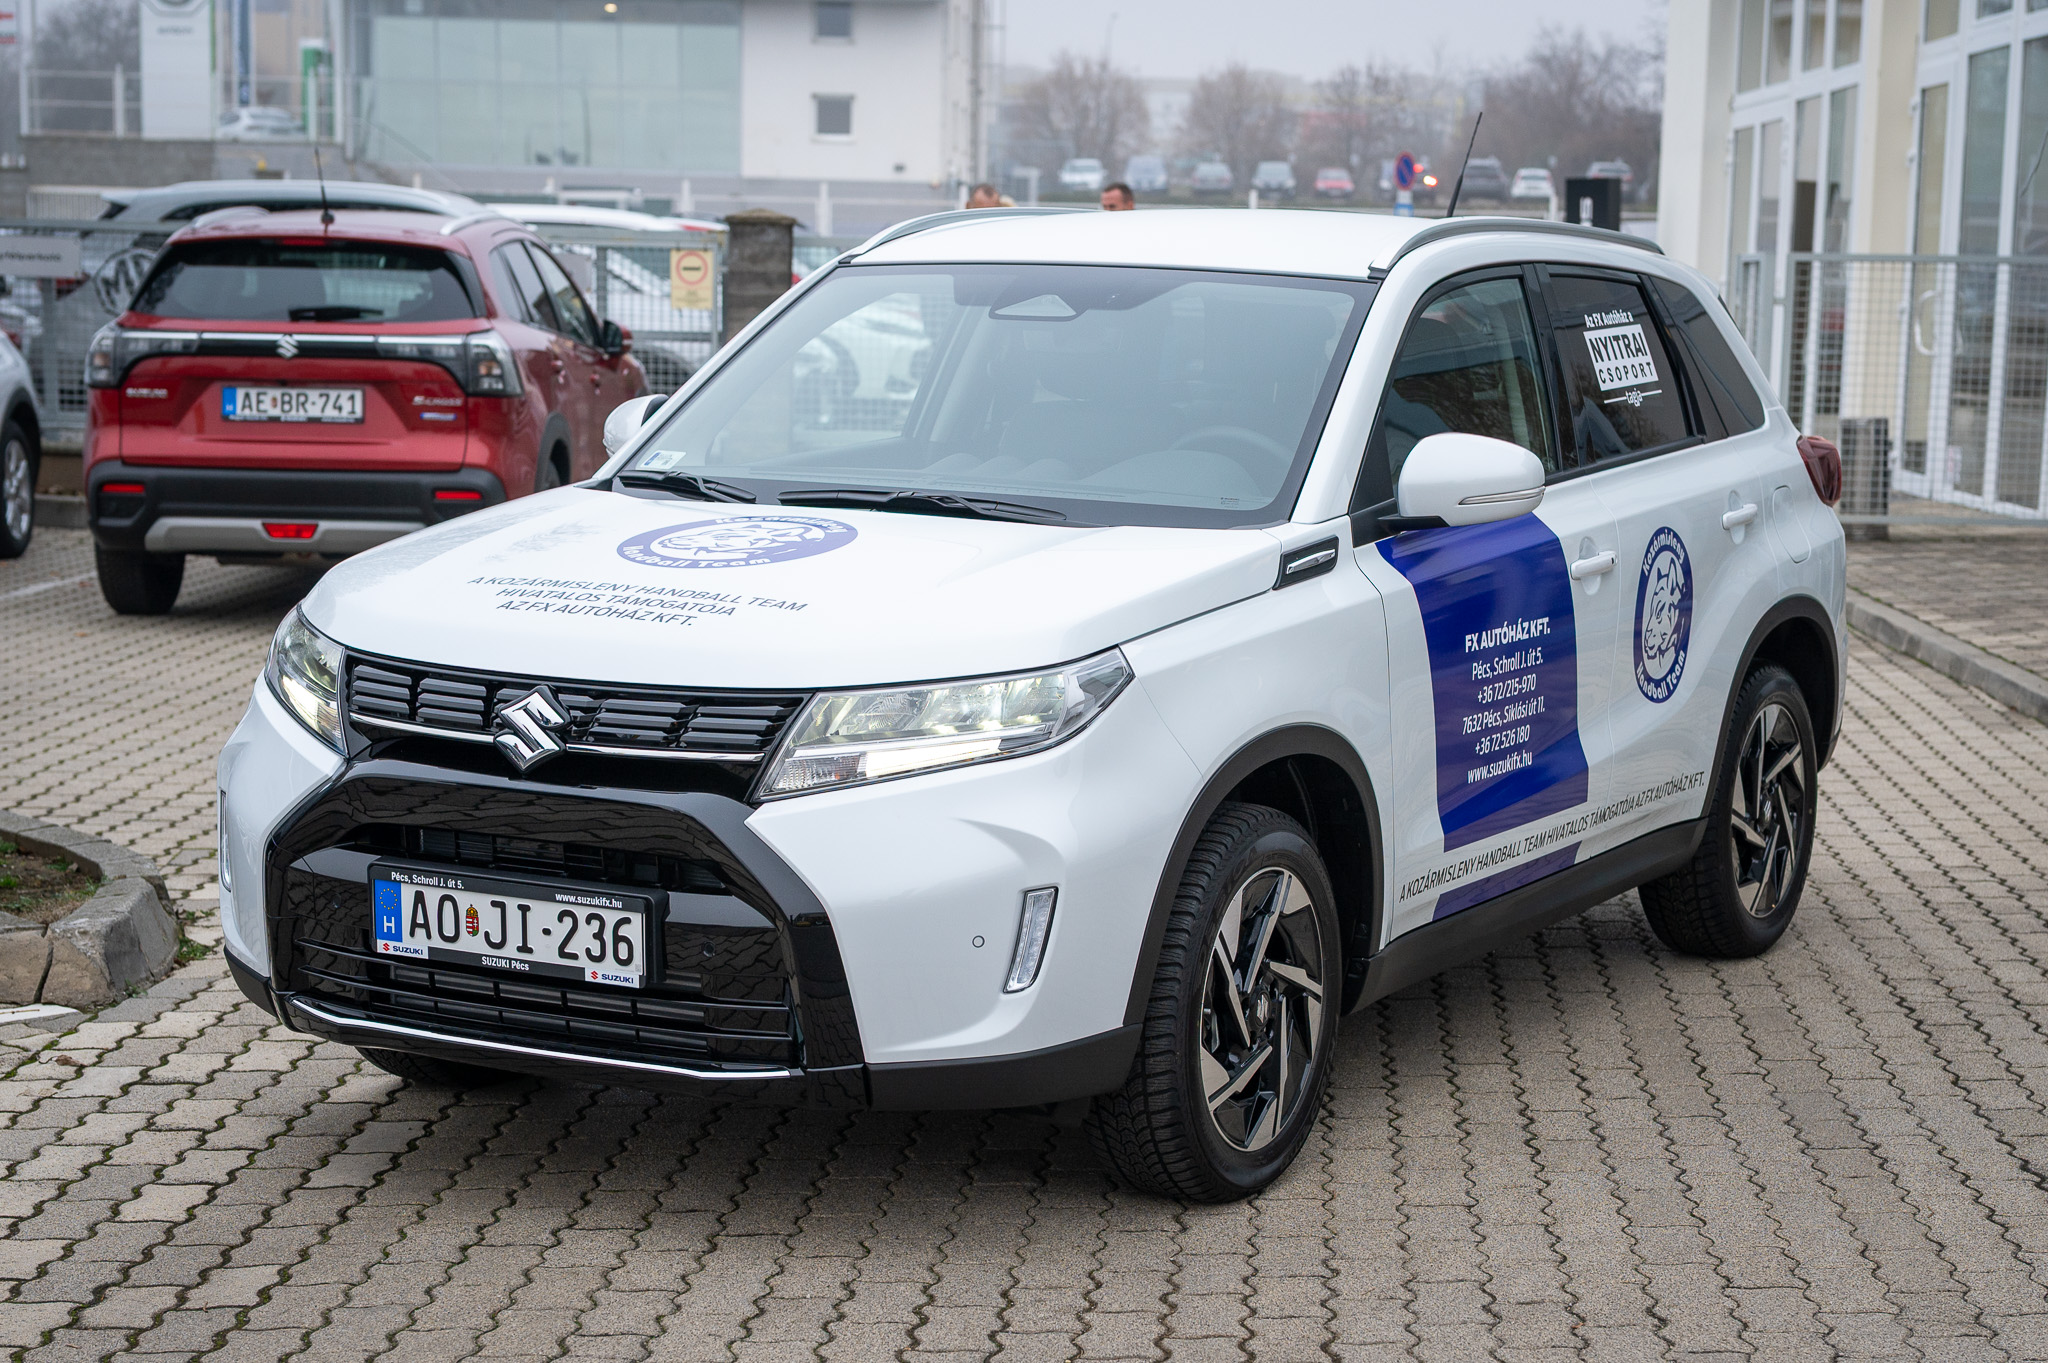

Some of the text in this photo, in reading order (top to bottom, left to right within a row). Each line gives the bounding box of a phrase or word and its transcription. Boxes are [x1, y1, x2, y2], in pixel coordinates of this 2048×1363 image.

[1584, 313, 1595, 328] Az
[1592, 312, 1604, 326] FX
[1627, 311, 1634, 322] a
[1588, 332, 1648, 363] NYITRAI
[1598, 361, 1653, 384] CSOPORT
[241, 391, 268, 413] AE
[1625, 387, 1643, 407] tagja
[697, 558, 771, 568] Team
[484, 577, 639, 592] KOZÁRMISLENY
[635, 586, 742, 604] HANDBALL
[748, 597, 809, 611] TEAM
[496, 588, 736, 616] HIVATALOS TÁMOGATÓJA
[496, 601, 698, 626] AZ FX AUTÓHÁZ KFT.
[1465, 616, 1551, 653] FX AUTÓHÁZ KFT.
[1472, 647, 1543, 681] Pécs, Schroll J. út 5.
[1636, 650, 1685, 699] Handball Team
[1477, 673, 1537, 704] +36 72/215-970
[1462, 696, 1545, 735] 7632 Pécs, Siklósi út 11.
[1475, 724, 1530, 755] +36 72 526 180
[1467, 749, 1533, 784] www.suzukifx.hu
[1399, 771, 1705, 903] A KOZÁRMISLENY HANDBALL TEAM HIVATALOS TÁMOGATÓJA AZ FX AUTÓHÁZ KFT.
[391, 872, 464, 889] Pécs, Schroll J. út 5.
[555, 893, 622, 908] www.suzukifx.hu
[383, 915, 395, 934] H
[409, 890, 634, 967] AO JI-236
[392, 945, 423, 956] SUZUKI
[482, 956, 529, 971] SUZUKI Pécs
[601, 973, 634, 984] SUZUKI
